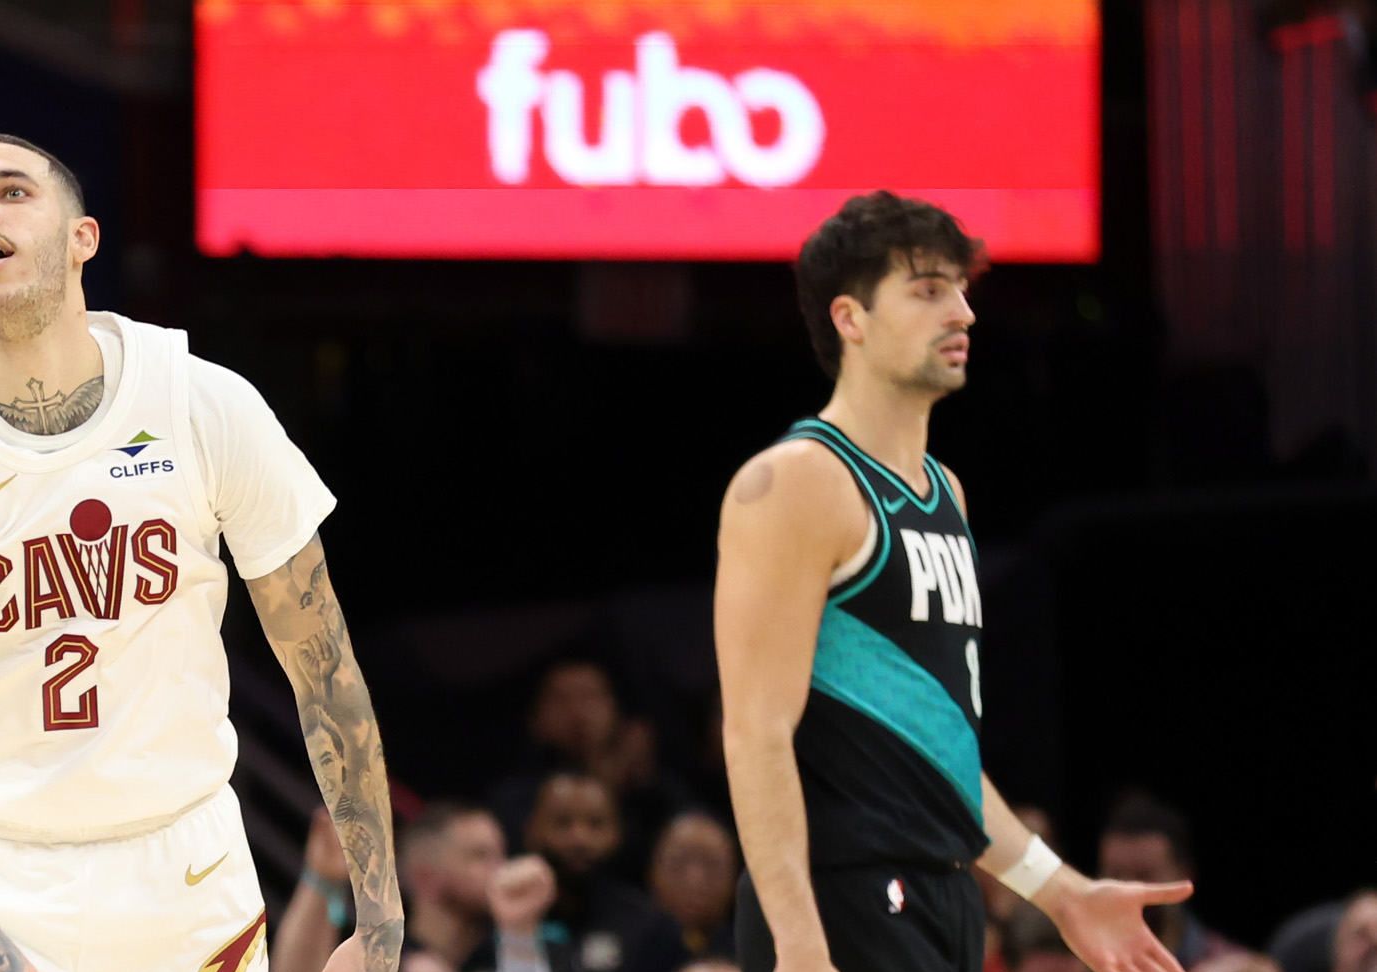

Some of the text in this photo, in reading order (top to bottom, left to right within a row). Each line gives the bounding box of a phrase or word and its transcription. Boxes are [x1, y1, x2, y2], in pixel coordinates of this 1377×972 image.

[476, 27, 826, 189] fubo
[109, 459, 175, 479] CLIFFS
[42, 633, 100, 732] 2
